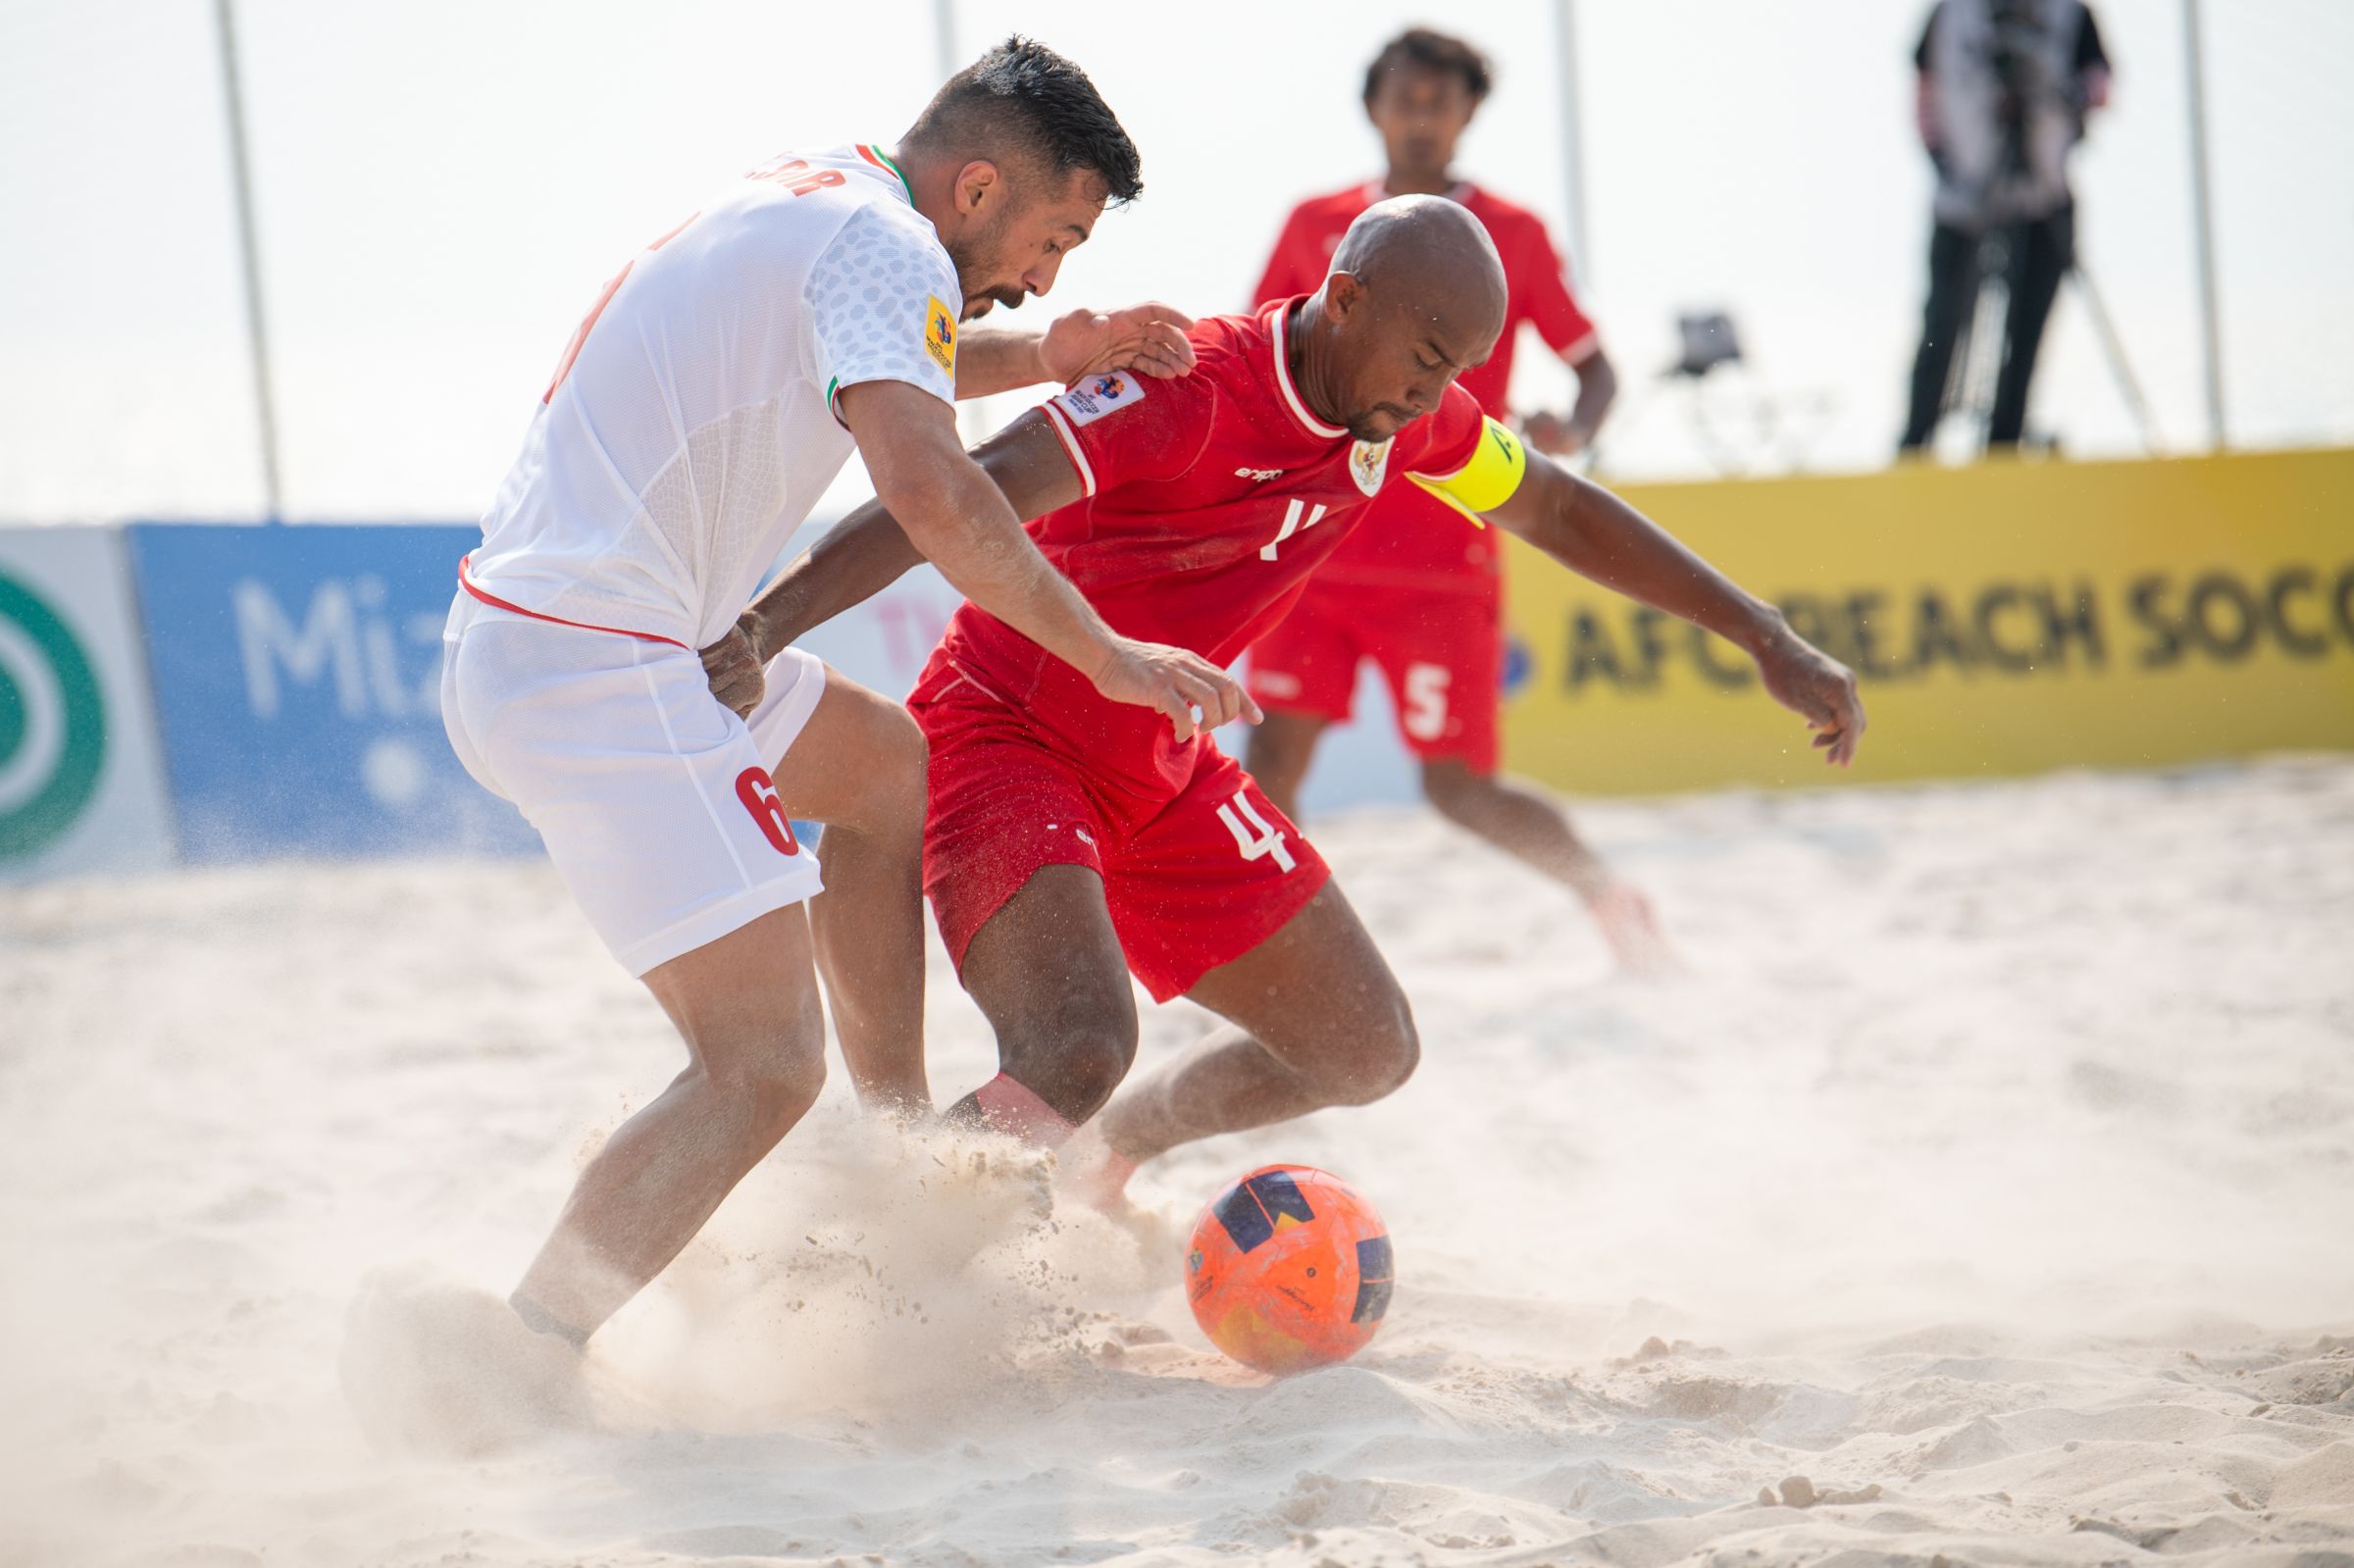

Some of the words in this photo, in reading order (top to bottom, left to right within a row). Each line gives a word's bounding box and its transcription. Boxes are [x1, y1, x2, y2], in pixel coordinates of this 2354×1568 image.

[1403, 661, 1452, 741] 5
[735, 766, 799, 856] 6
[1215, 789, 1297, 874] 4
